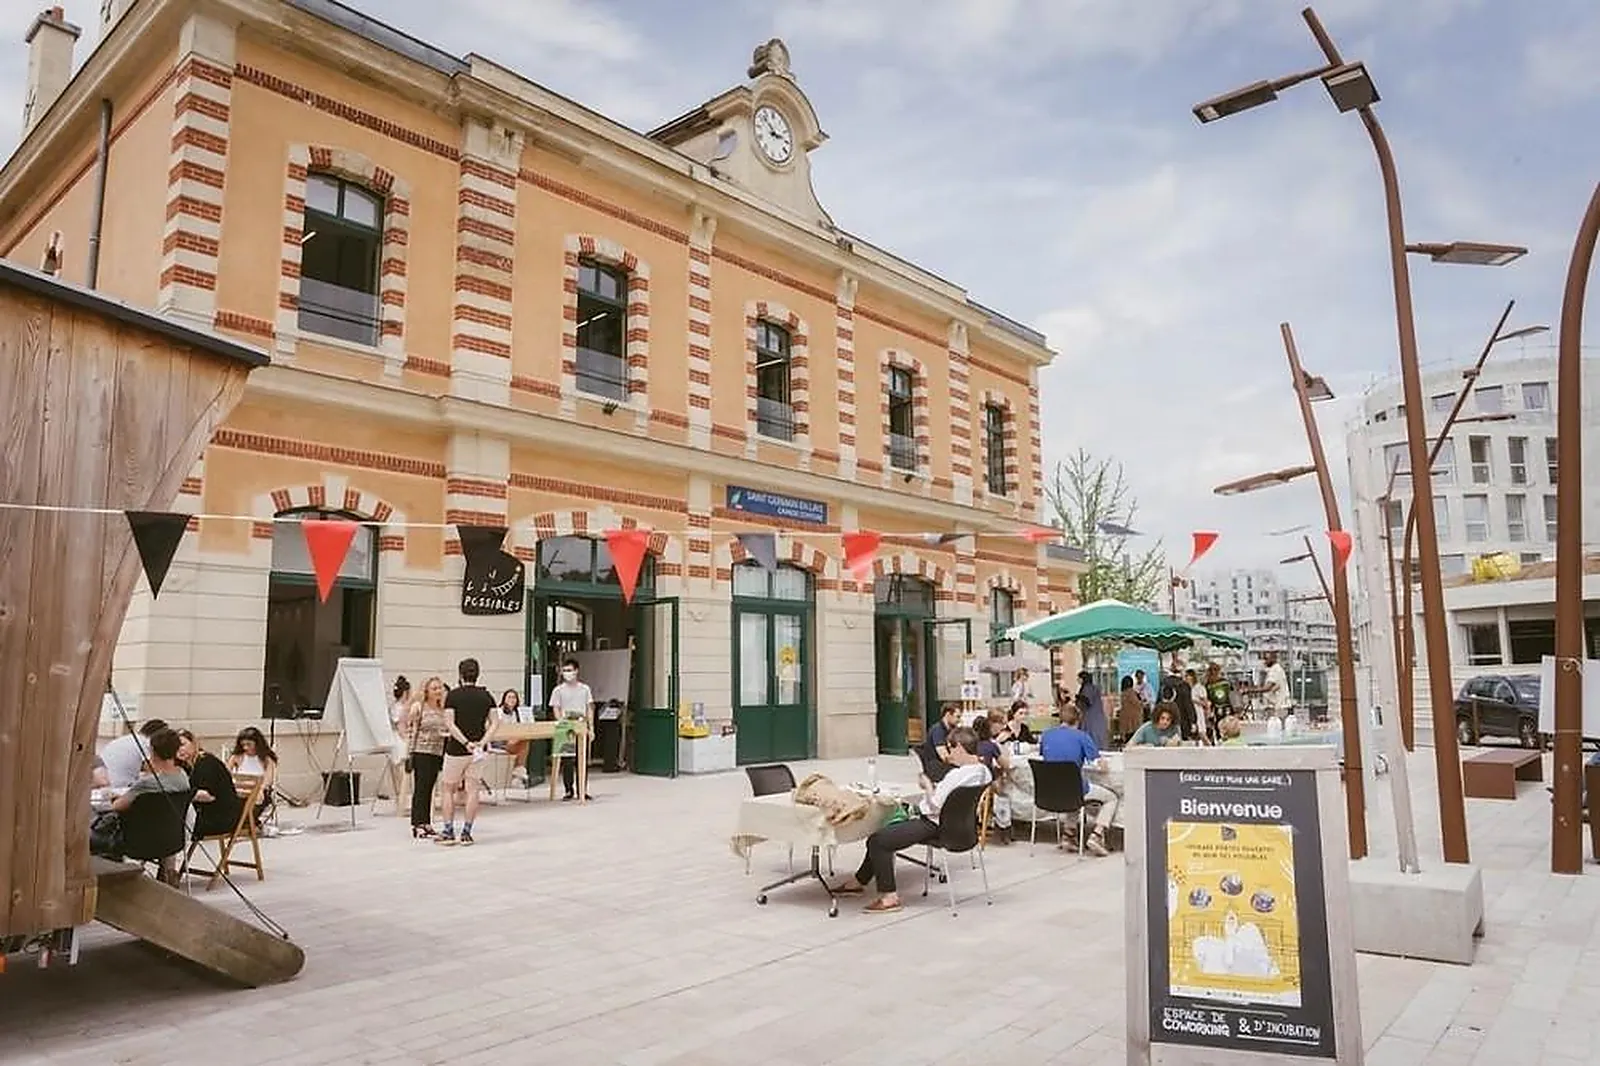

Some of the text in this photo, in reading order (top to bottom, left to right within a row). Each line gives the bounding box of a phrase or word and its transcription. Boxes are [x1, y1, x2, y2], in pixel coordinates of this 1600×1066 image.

[464, 595, 520, 611] POSSIBLES
[1180, 798, 1283, 819] Bienvenue
[1162, 1017, 1321, 1040] COWORKING & D'INCUBATION
